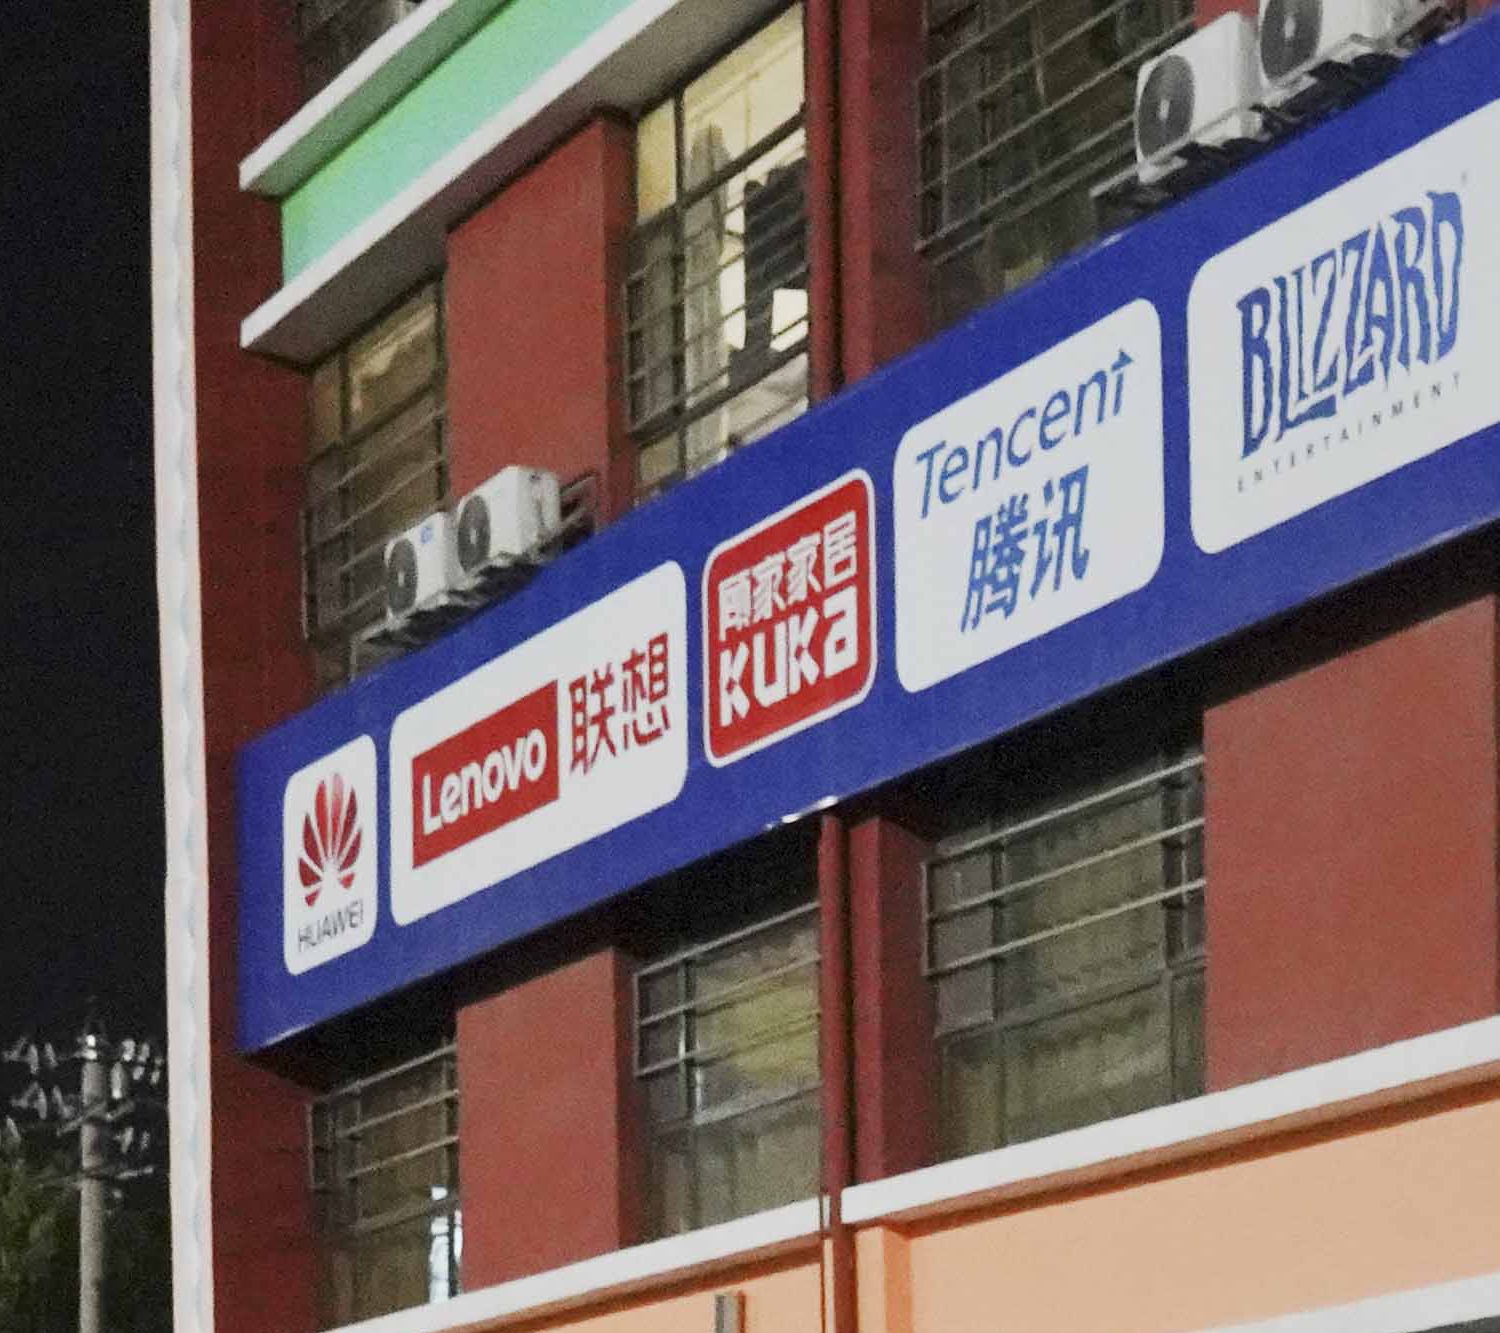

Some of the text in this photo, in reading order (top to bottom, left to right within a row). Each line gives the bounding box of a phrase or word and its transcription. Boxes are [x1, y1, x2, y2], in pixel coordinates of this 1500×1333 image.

[1236, 190, 1464, 461] BLIZZARD
[916, 348, 1135, 520] Tencent
[1236, 371, 1462, 494] ENTERTAINMENT
[718, 509, 858, 642] 顾家家居
[959, 463, 1091, 633] 腾讯
[422, 631, 672, 837] Lenovo 联想
[297, 897, 364, 953] HUAWEI
